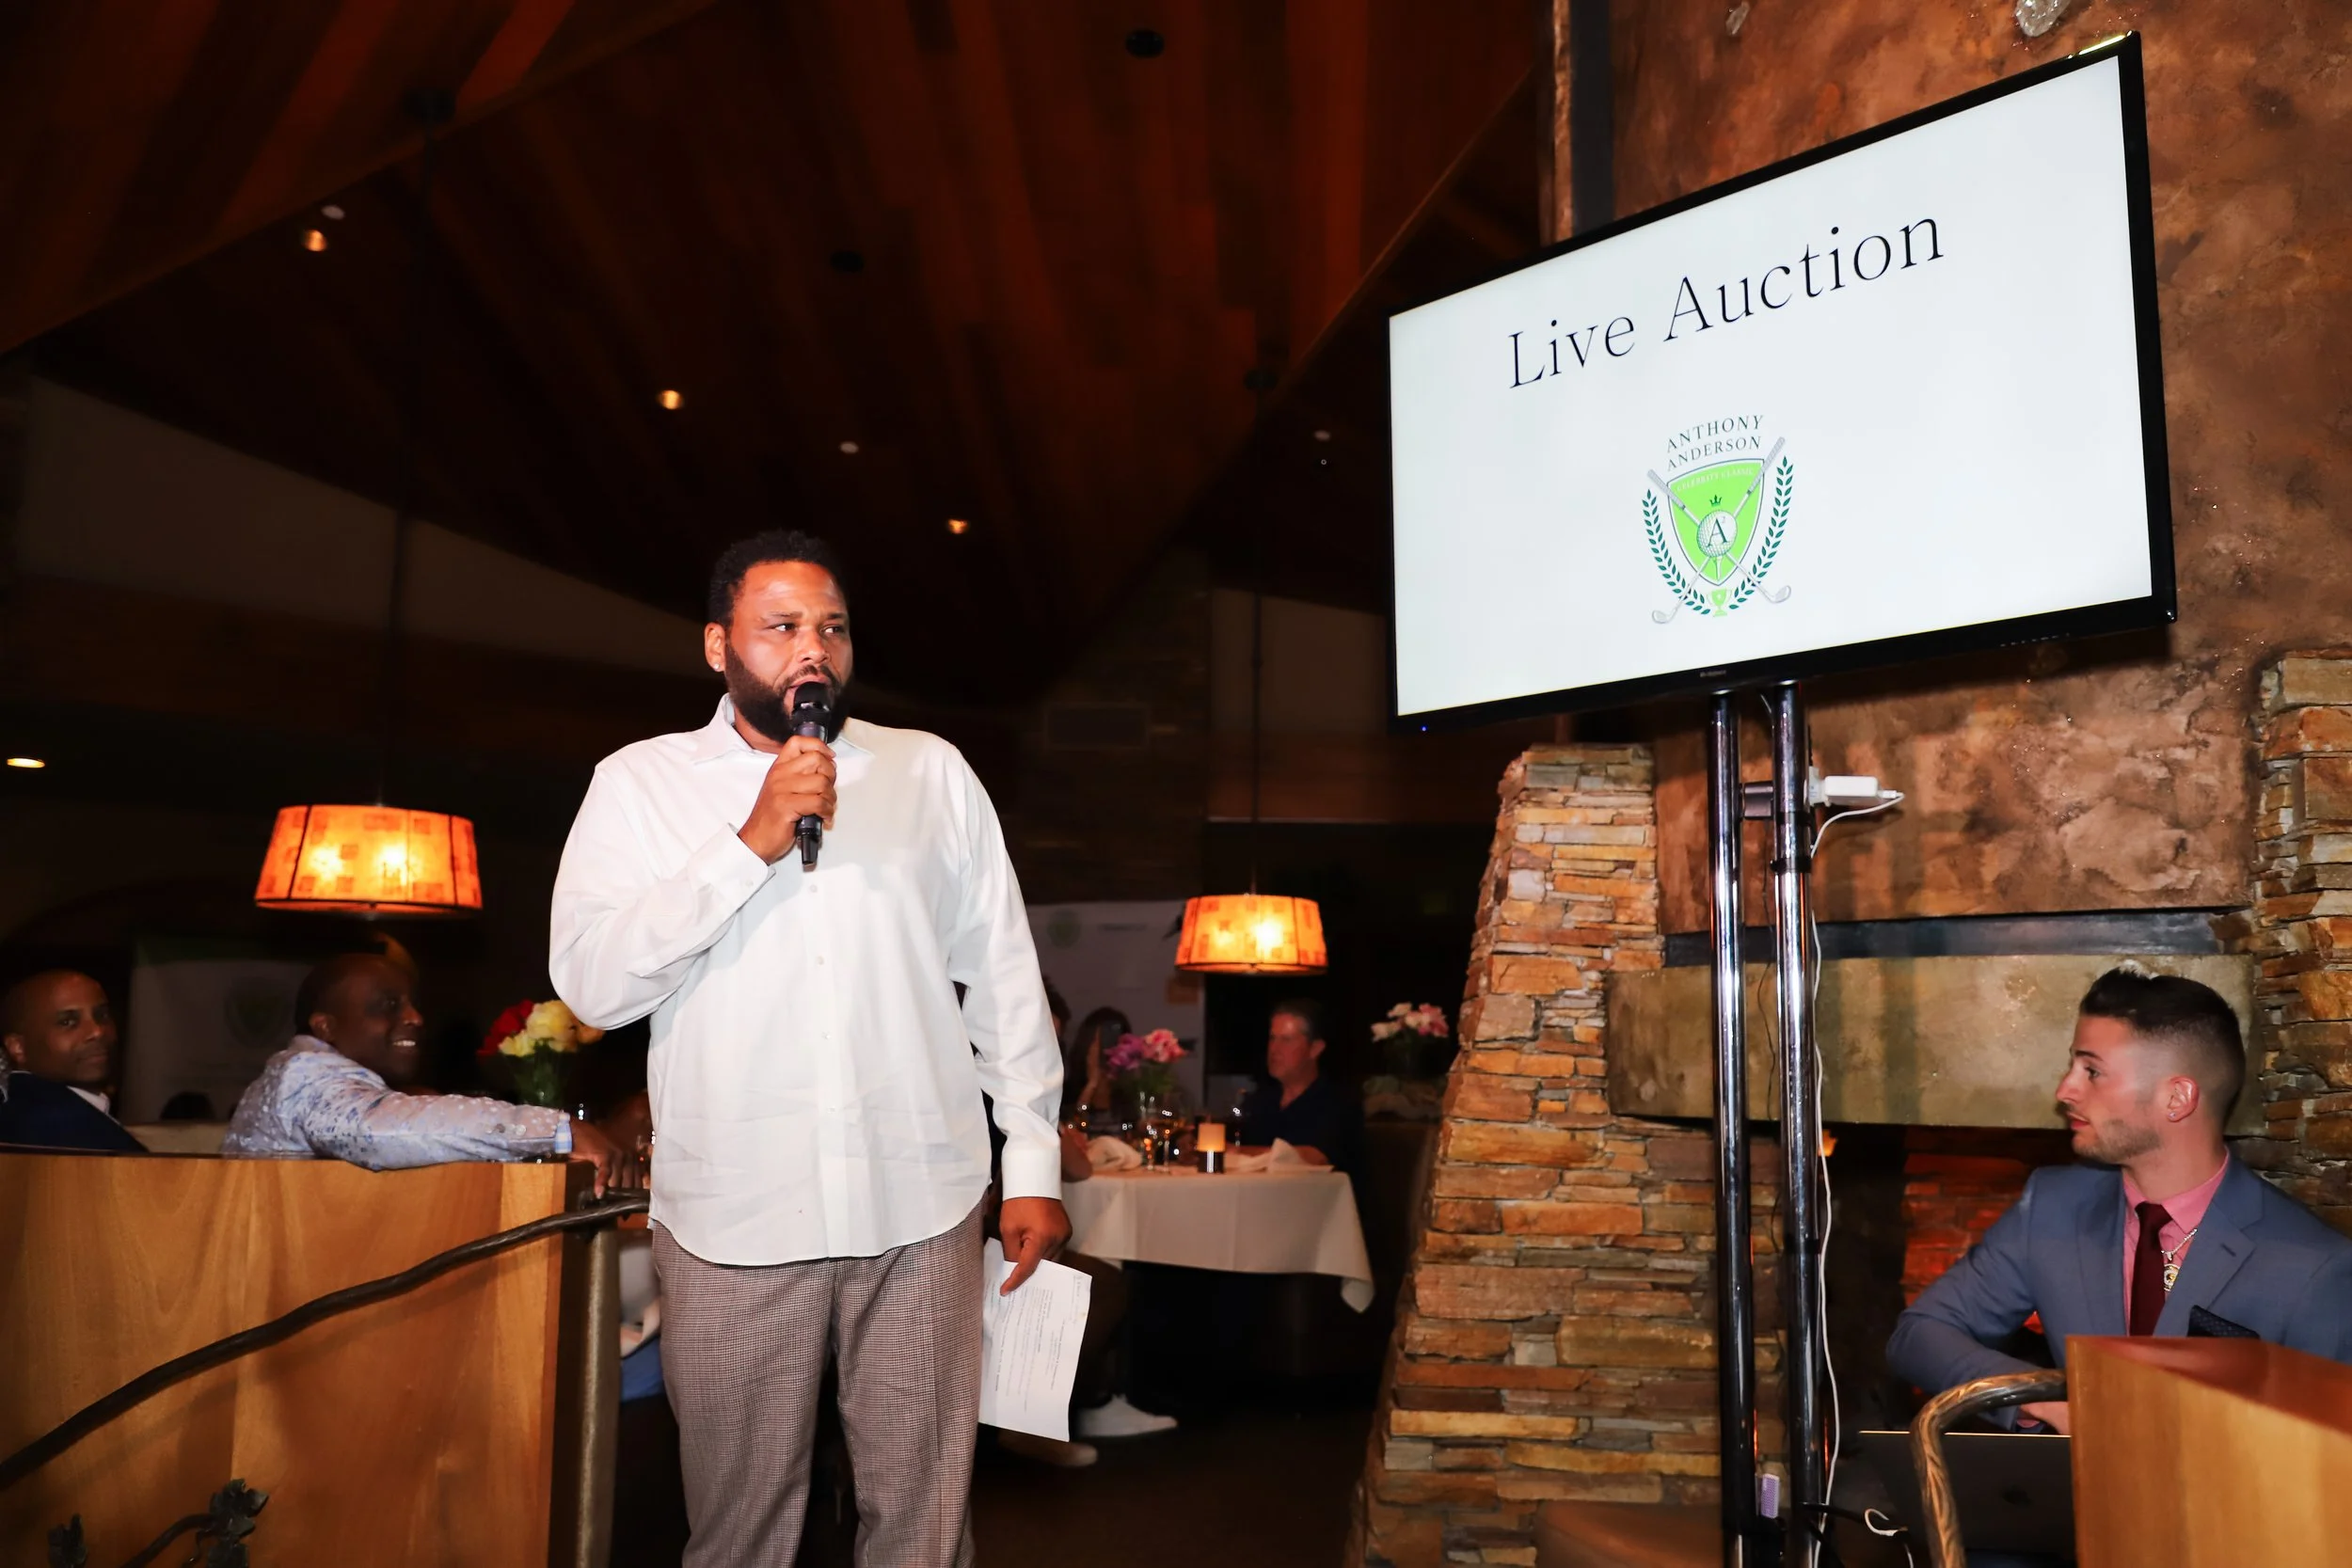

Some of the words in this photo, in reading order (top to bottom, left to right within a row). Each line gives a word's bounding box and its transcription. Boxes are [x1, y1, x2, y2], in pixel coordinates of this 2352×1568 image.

[1508, 314, 1636, 389] Live
[1662, 214, 1946, 343] Auction
[1667, 415, 1764, 453] ANTHONY
[1667, 436, 1761, 471] ANDERSON
